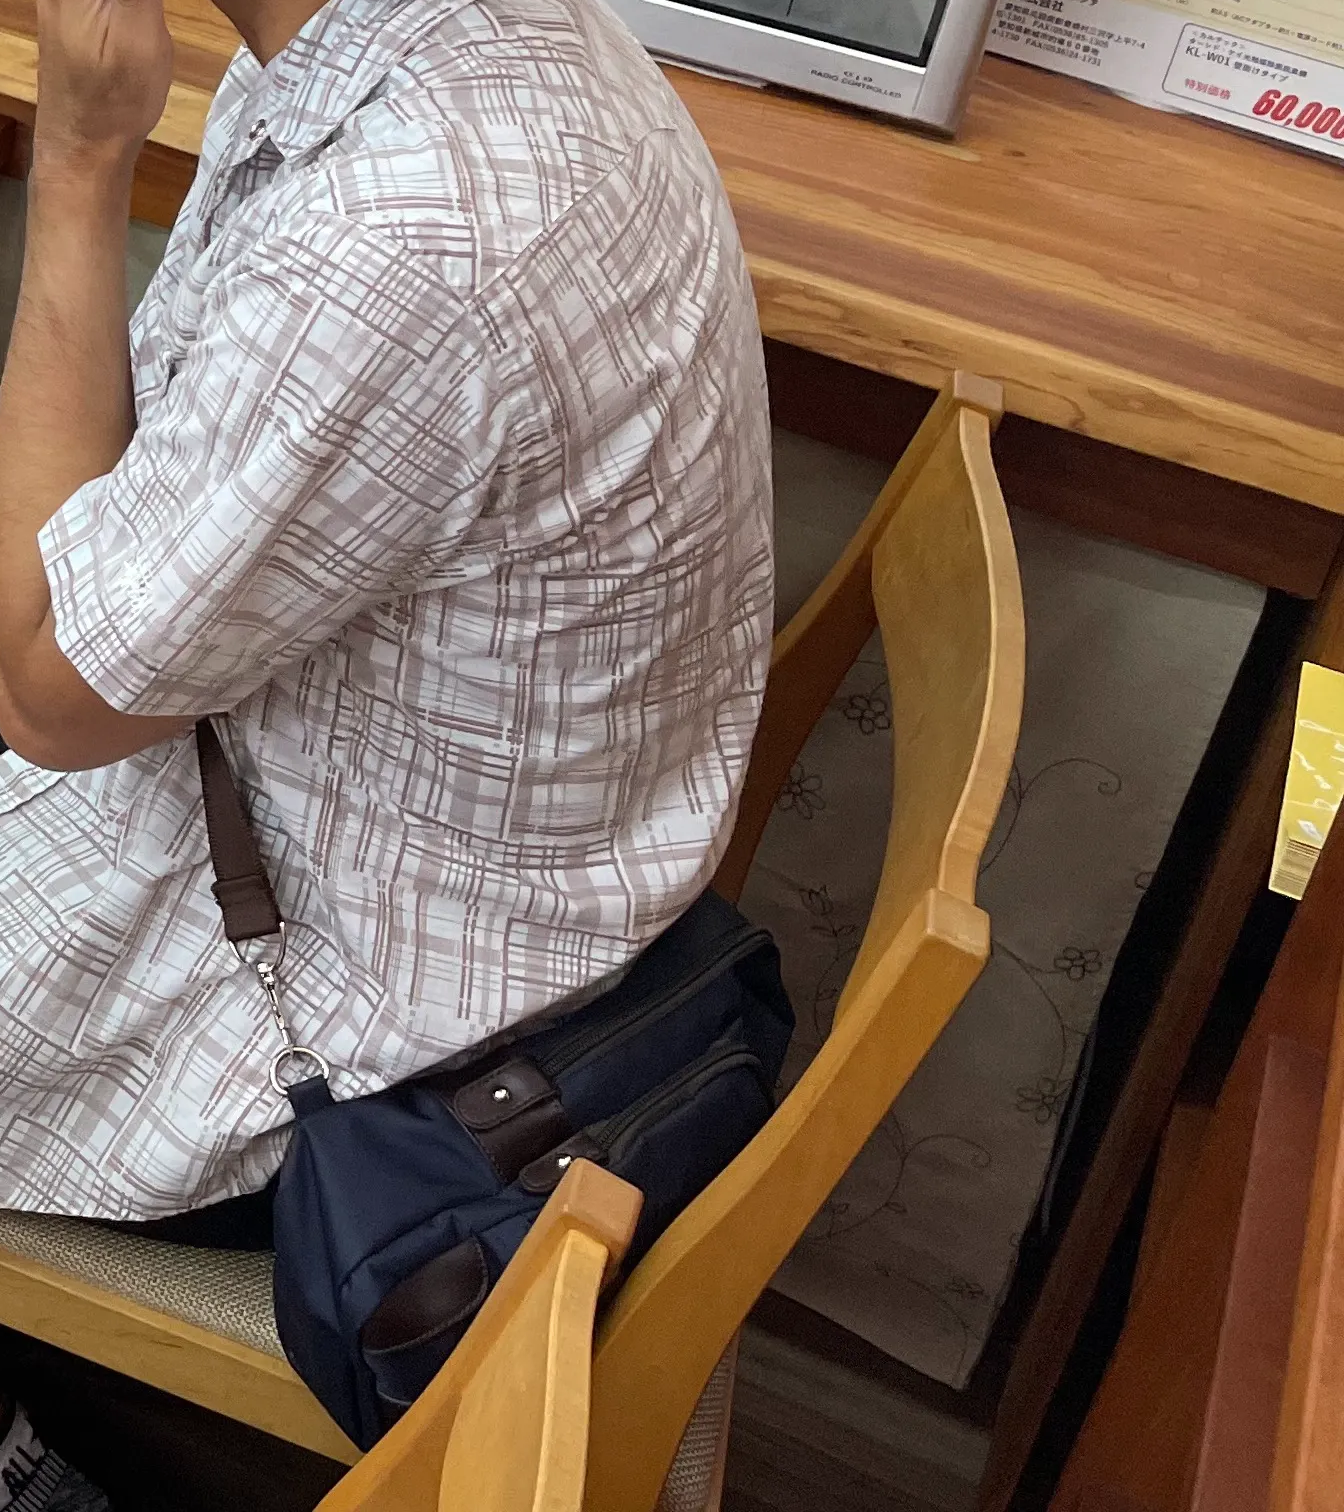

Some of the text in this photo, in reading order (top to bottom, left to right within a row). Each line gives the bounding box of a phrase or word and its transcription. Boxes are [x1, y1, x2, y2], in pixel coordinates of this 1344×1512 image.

[1185, 45, 1230, 67] KL-W01
[811, 68, 902, 99] RADIO CONTROLLED
[1184, 78, 1231, 100] 特別価格
